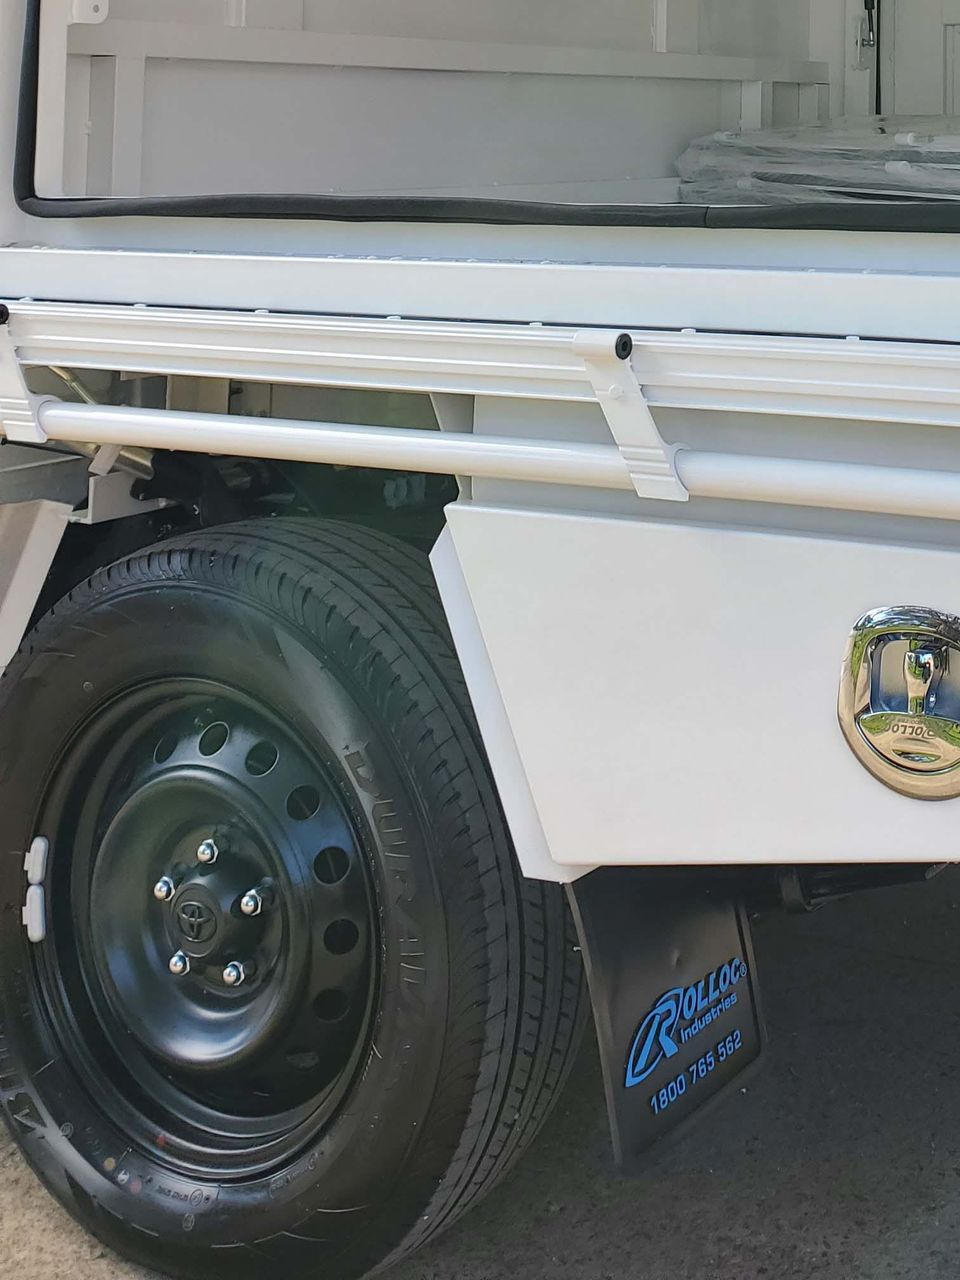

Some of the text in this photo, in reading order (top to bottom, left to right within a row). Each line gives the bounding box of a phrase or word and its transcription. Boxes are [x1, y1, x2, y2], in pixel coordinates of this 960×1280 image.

[680, 992, 738, 1044] Industries
[651, 1030, 742, 1115] 1800 765 562
